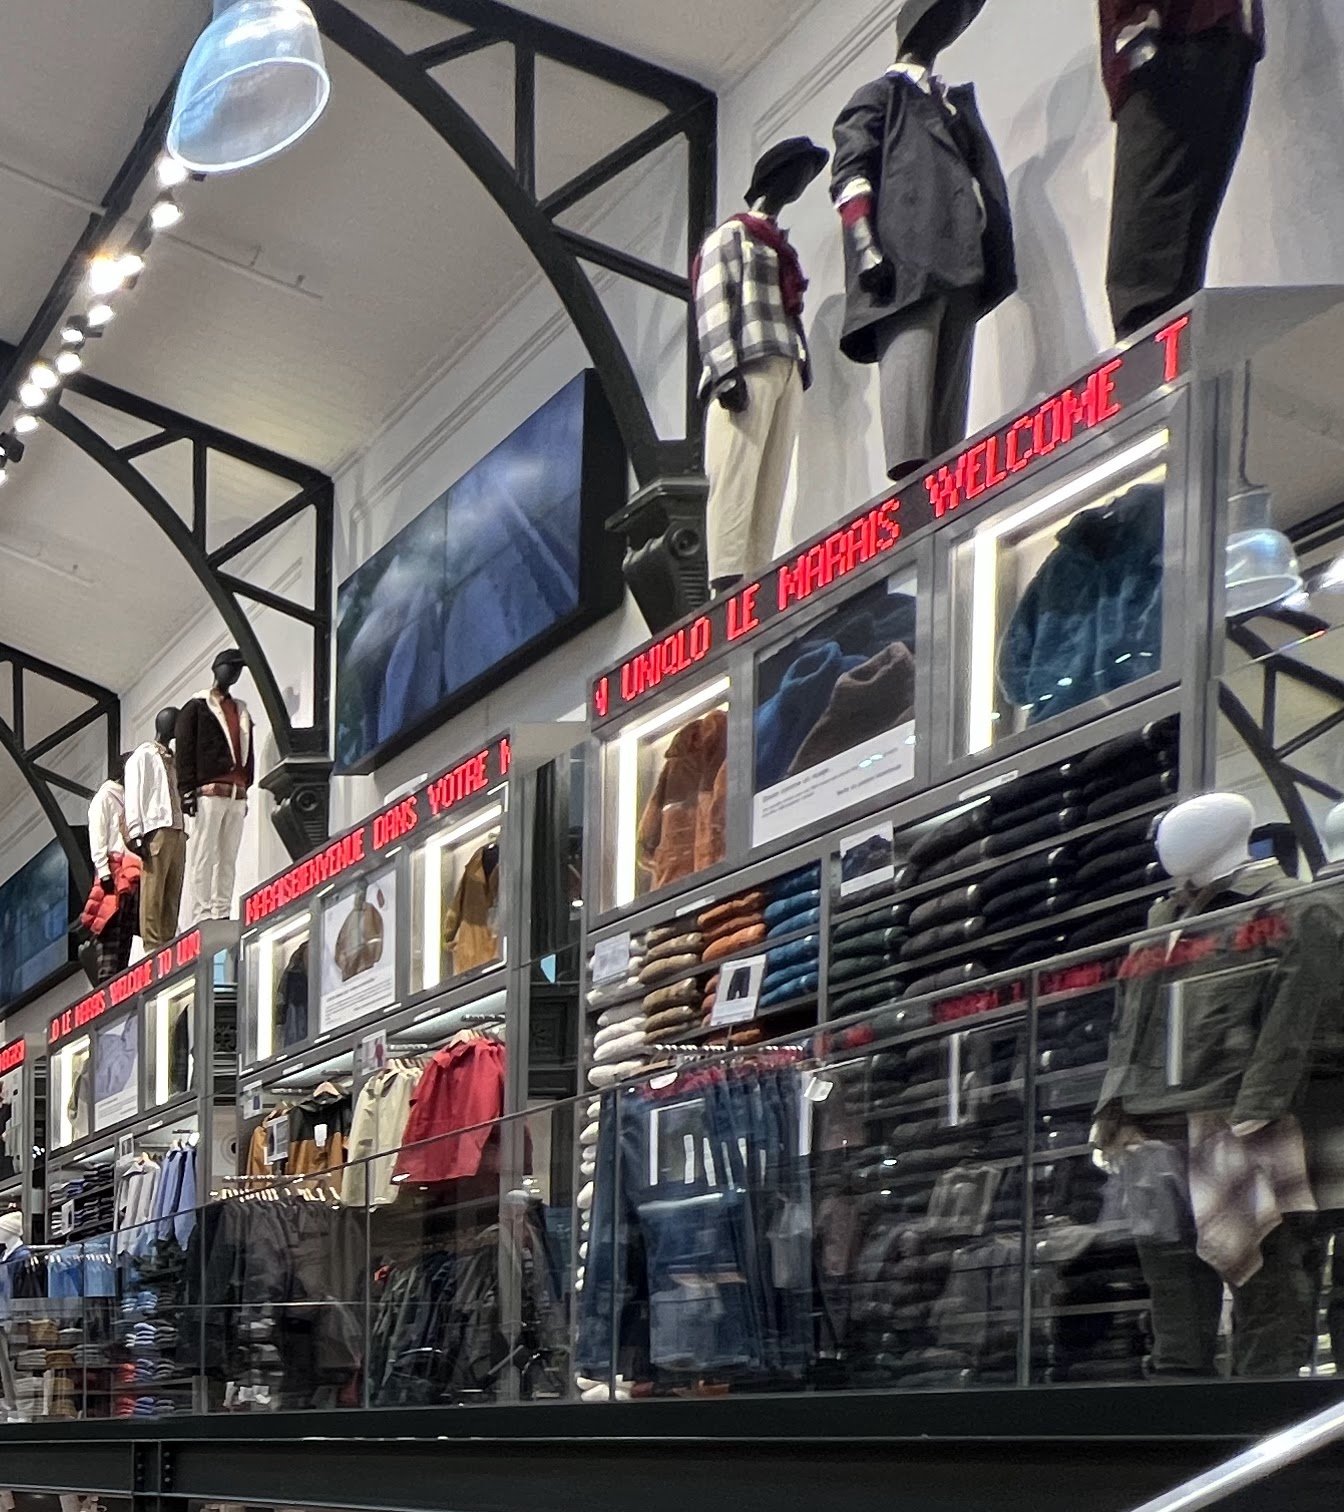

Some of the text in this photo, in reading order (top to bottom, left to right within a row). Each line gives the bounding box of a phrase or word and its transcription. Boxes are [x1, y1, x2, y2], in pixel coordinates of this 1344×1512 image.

[925, 315, 1189, 518] WELCOME T
[621, 615, 711, 702] UNIQLO
[727, 582, 761, 641] LE
[779, 498, 901, 611] MARAIS
[372, 795, 418, 850] DANS
[427, 749, 490, 816] VOTRE
